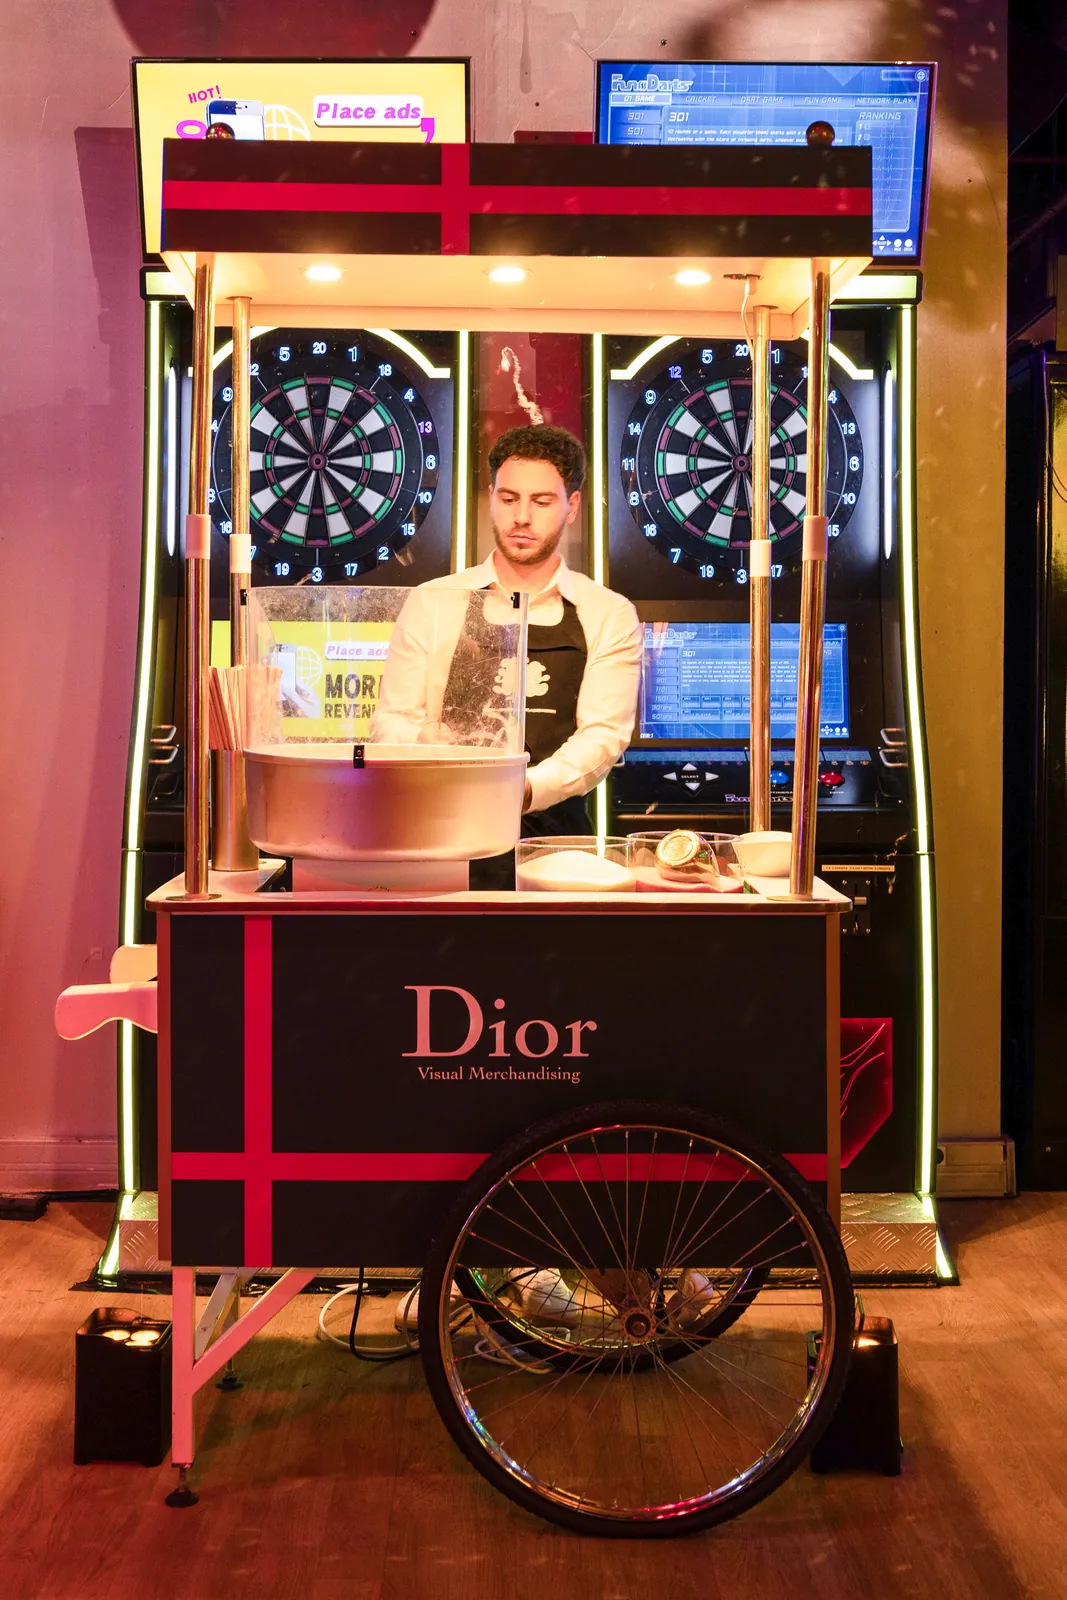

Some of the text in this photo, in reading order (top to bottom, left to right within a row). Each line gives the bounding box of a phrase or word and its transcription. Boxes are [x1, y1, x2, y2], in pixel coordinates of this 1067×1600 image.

[188, 85, 221, 104] HOT!
[317, 103, 421, 119] Place ads
[628, 112, 644, 120] 301
[669, 112, 689, 121] 301
[859, 112, 901, 120] RANKING
[627, 127, 644, 135] 501
[279, 346, 290, 361] 5
[313, 342, 327, 354] 20
[348, 346, 358, 361] 1
[736, 344, 749, 357] 20
[702, 349, 713, 364] 5
[771, 348, 780, 364] 1
[379, 363, 392, 376] 18
[669, 366, 682, 378] 12
[801, 365, 809, 378] 1
[222, 386, 234, 402] 9
[404, 388, 414, 403] 4
[645, 389, 657, 404] 9
[828, 389, 838, 404] 4
[418, 421, 433, 434] 13
[628, 422, 642, 436] 14
[842, 423, 856, 435] 13
[426, 454, 436, 471] 6
[622, 458, 635, 471] 11
[850, 456, 860, 472] 6
[418, 492, 432, 504] 10
[630, 491, 640, 506] 8
[842, 493, 856, 505] 10
[219, 520, 233, 534] 16
[401, 522, 416, 536] 15
[643, 523, 657, 537] 16
[827, 524, 840, 537] 15
[378, 546, 389, 561] 2
[670, 548, 682, 564] 7
[275, 562, 290, 576] 19
[312, 567, 323, 582] 3
[344, 562, 358, 576] 17
[700, 564, 715, 578] 19
[736, 568, 748, 584] 3
[770, 564, 783, 578] 17
[327, 645, 363, 656] Place
[682, 650, 696, 658] 301
[402, 985, 598, 1058] Dior
[417, 1066, 581, 1084] Visual Merchandising
